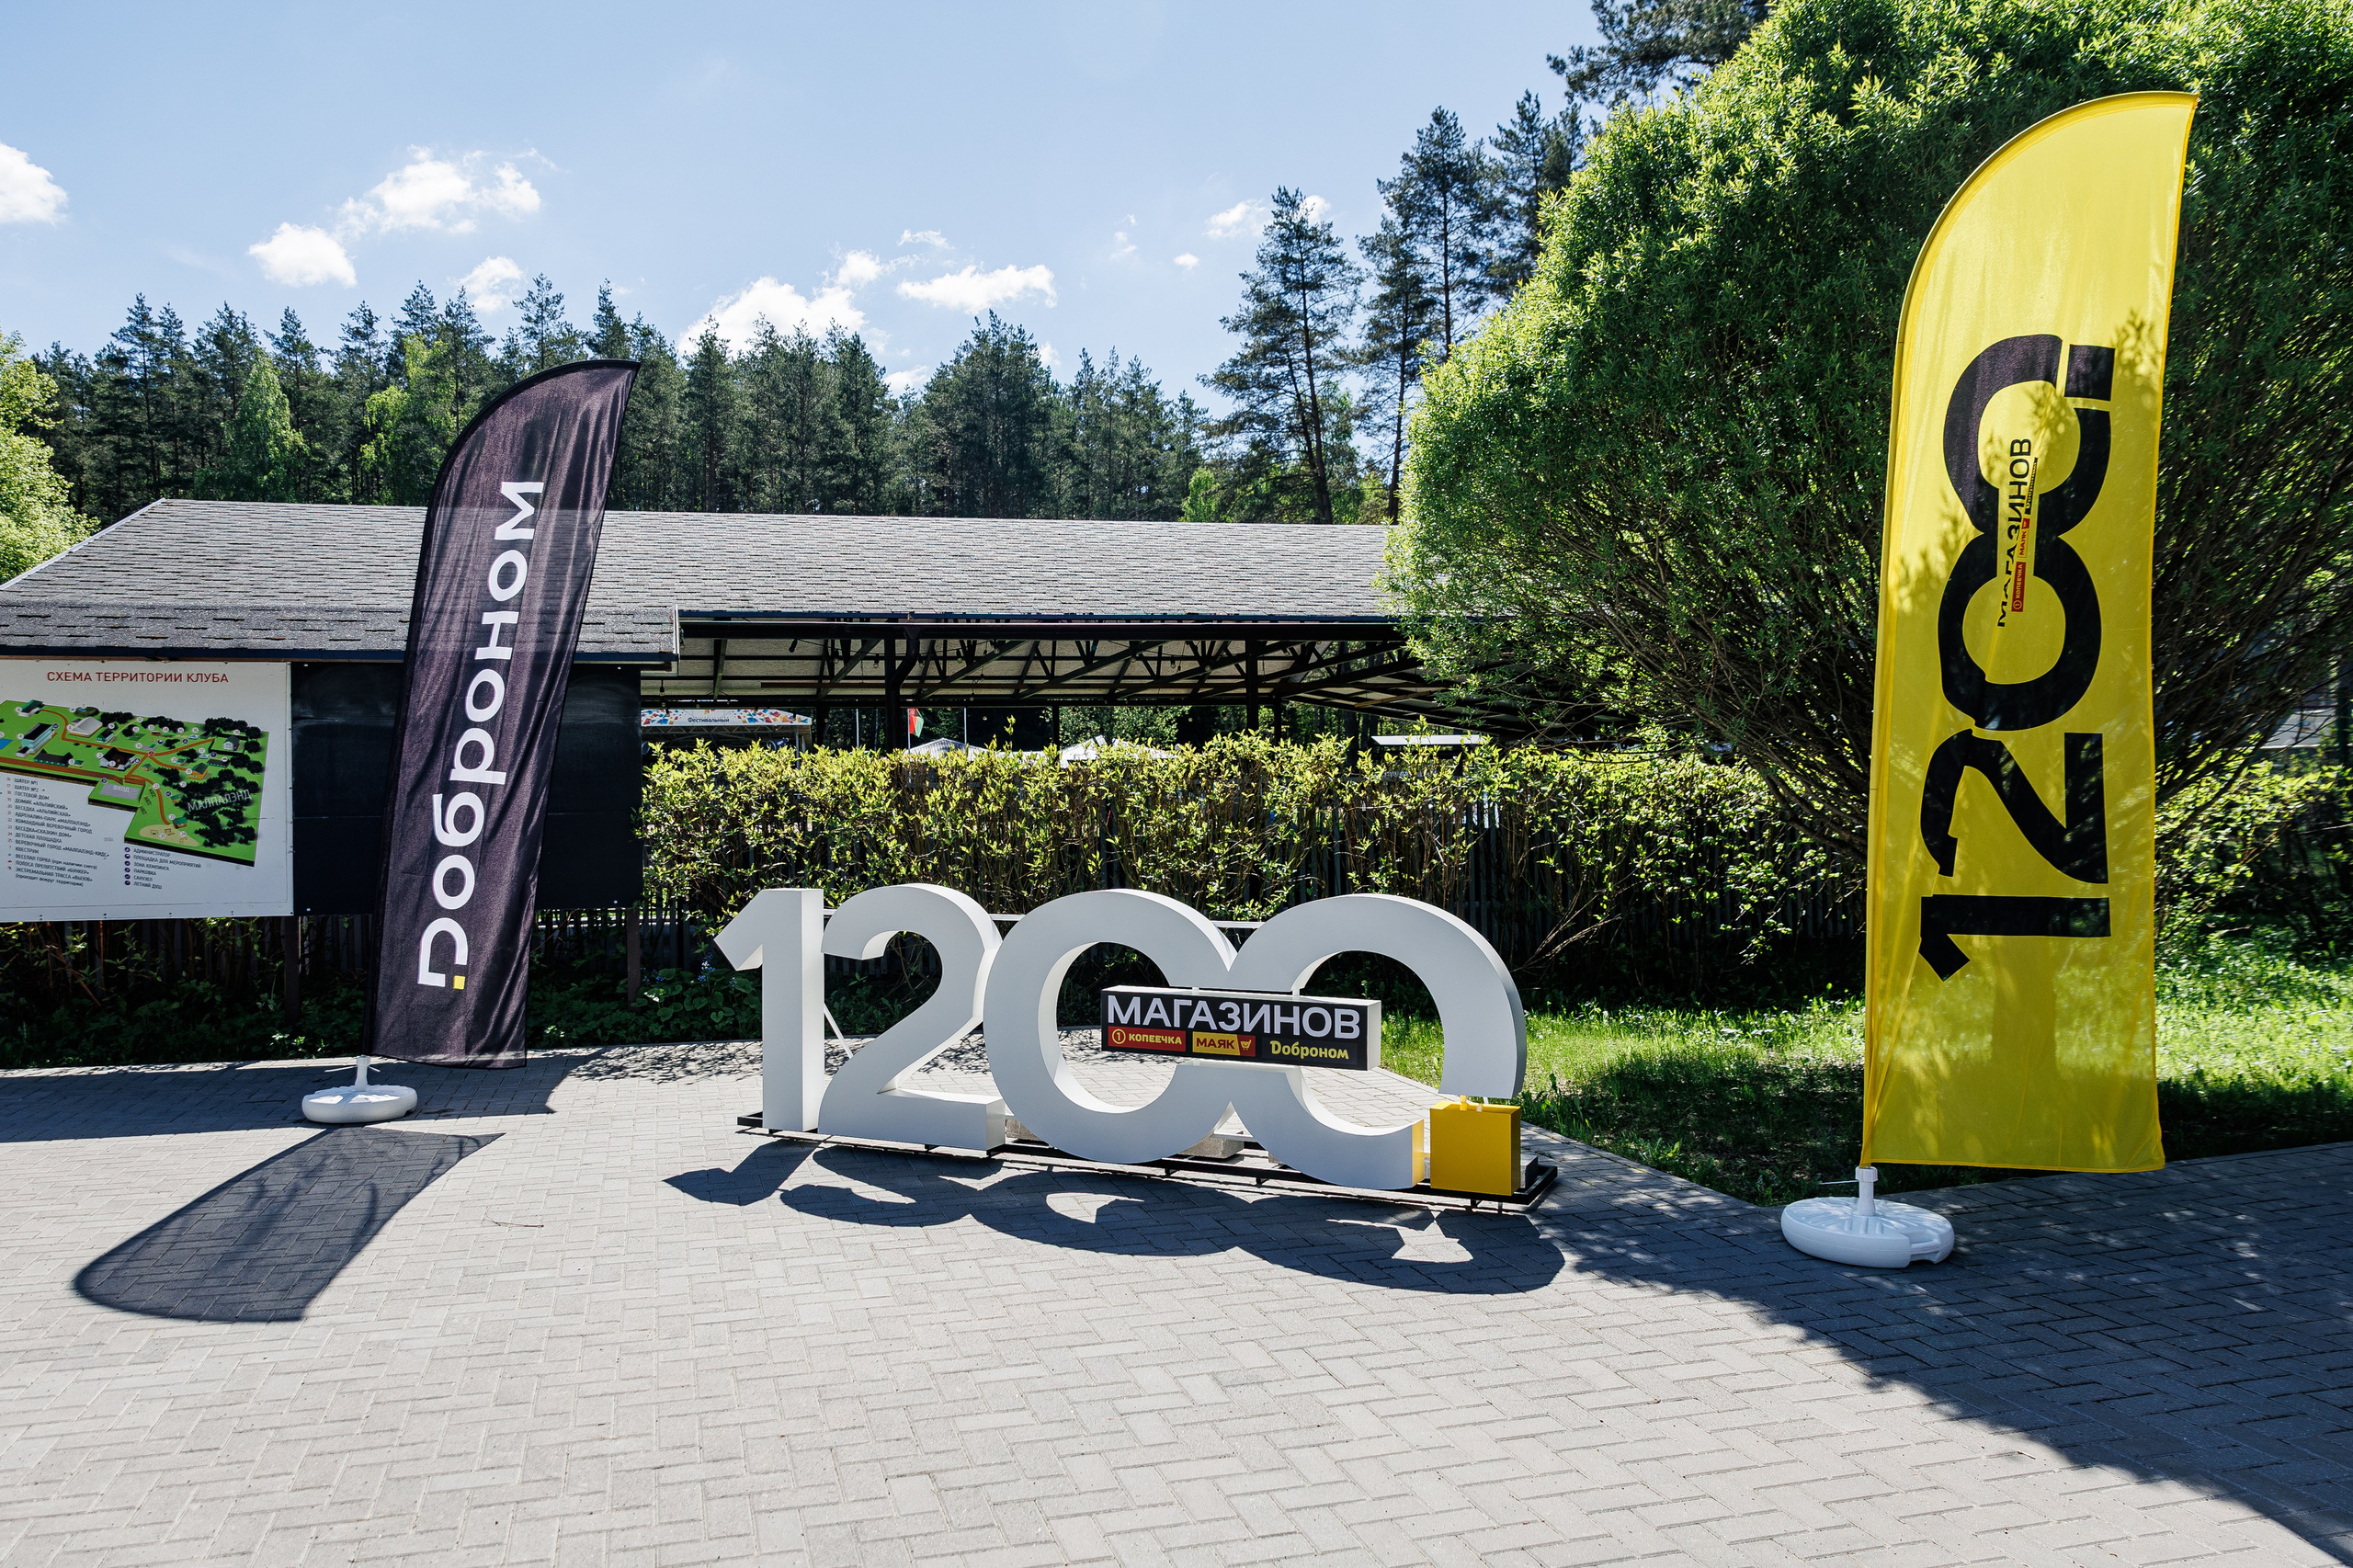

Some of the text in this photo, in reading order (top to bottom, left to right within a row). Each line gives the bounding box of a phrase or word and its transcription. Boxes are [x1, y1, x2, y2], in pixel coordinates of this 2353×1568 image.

[1996, 438, 2031, 627] ЗИНОВ
[1919, 334, 2114, 982] 1200
[47, 671, 229, 683] СХЕМА ТЕРРИТОРИИ КЛУБА
[417, 481, 544, 990] Доброном
[187, 789, 252, 812] МАЛПАЛЭНД
[16, 867, 54, 876] ЭКСТРЕМАЛЬНАЯ
[1108, 994, 1360, 1040] МАГАЗИНОВ
[716, 883, 1526, 1197] 1200
[1128, 1033, 1182, 1045] КОПЕЕЧКА
[1195, 1036, 1235, 1050] МАЯК
[1270, 1040, 1349, 1060] Доброном
